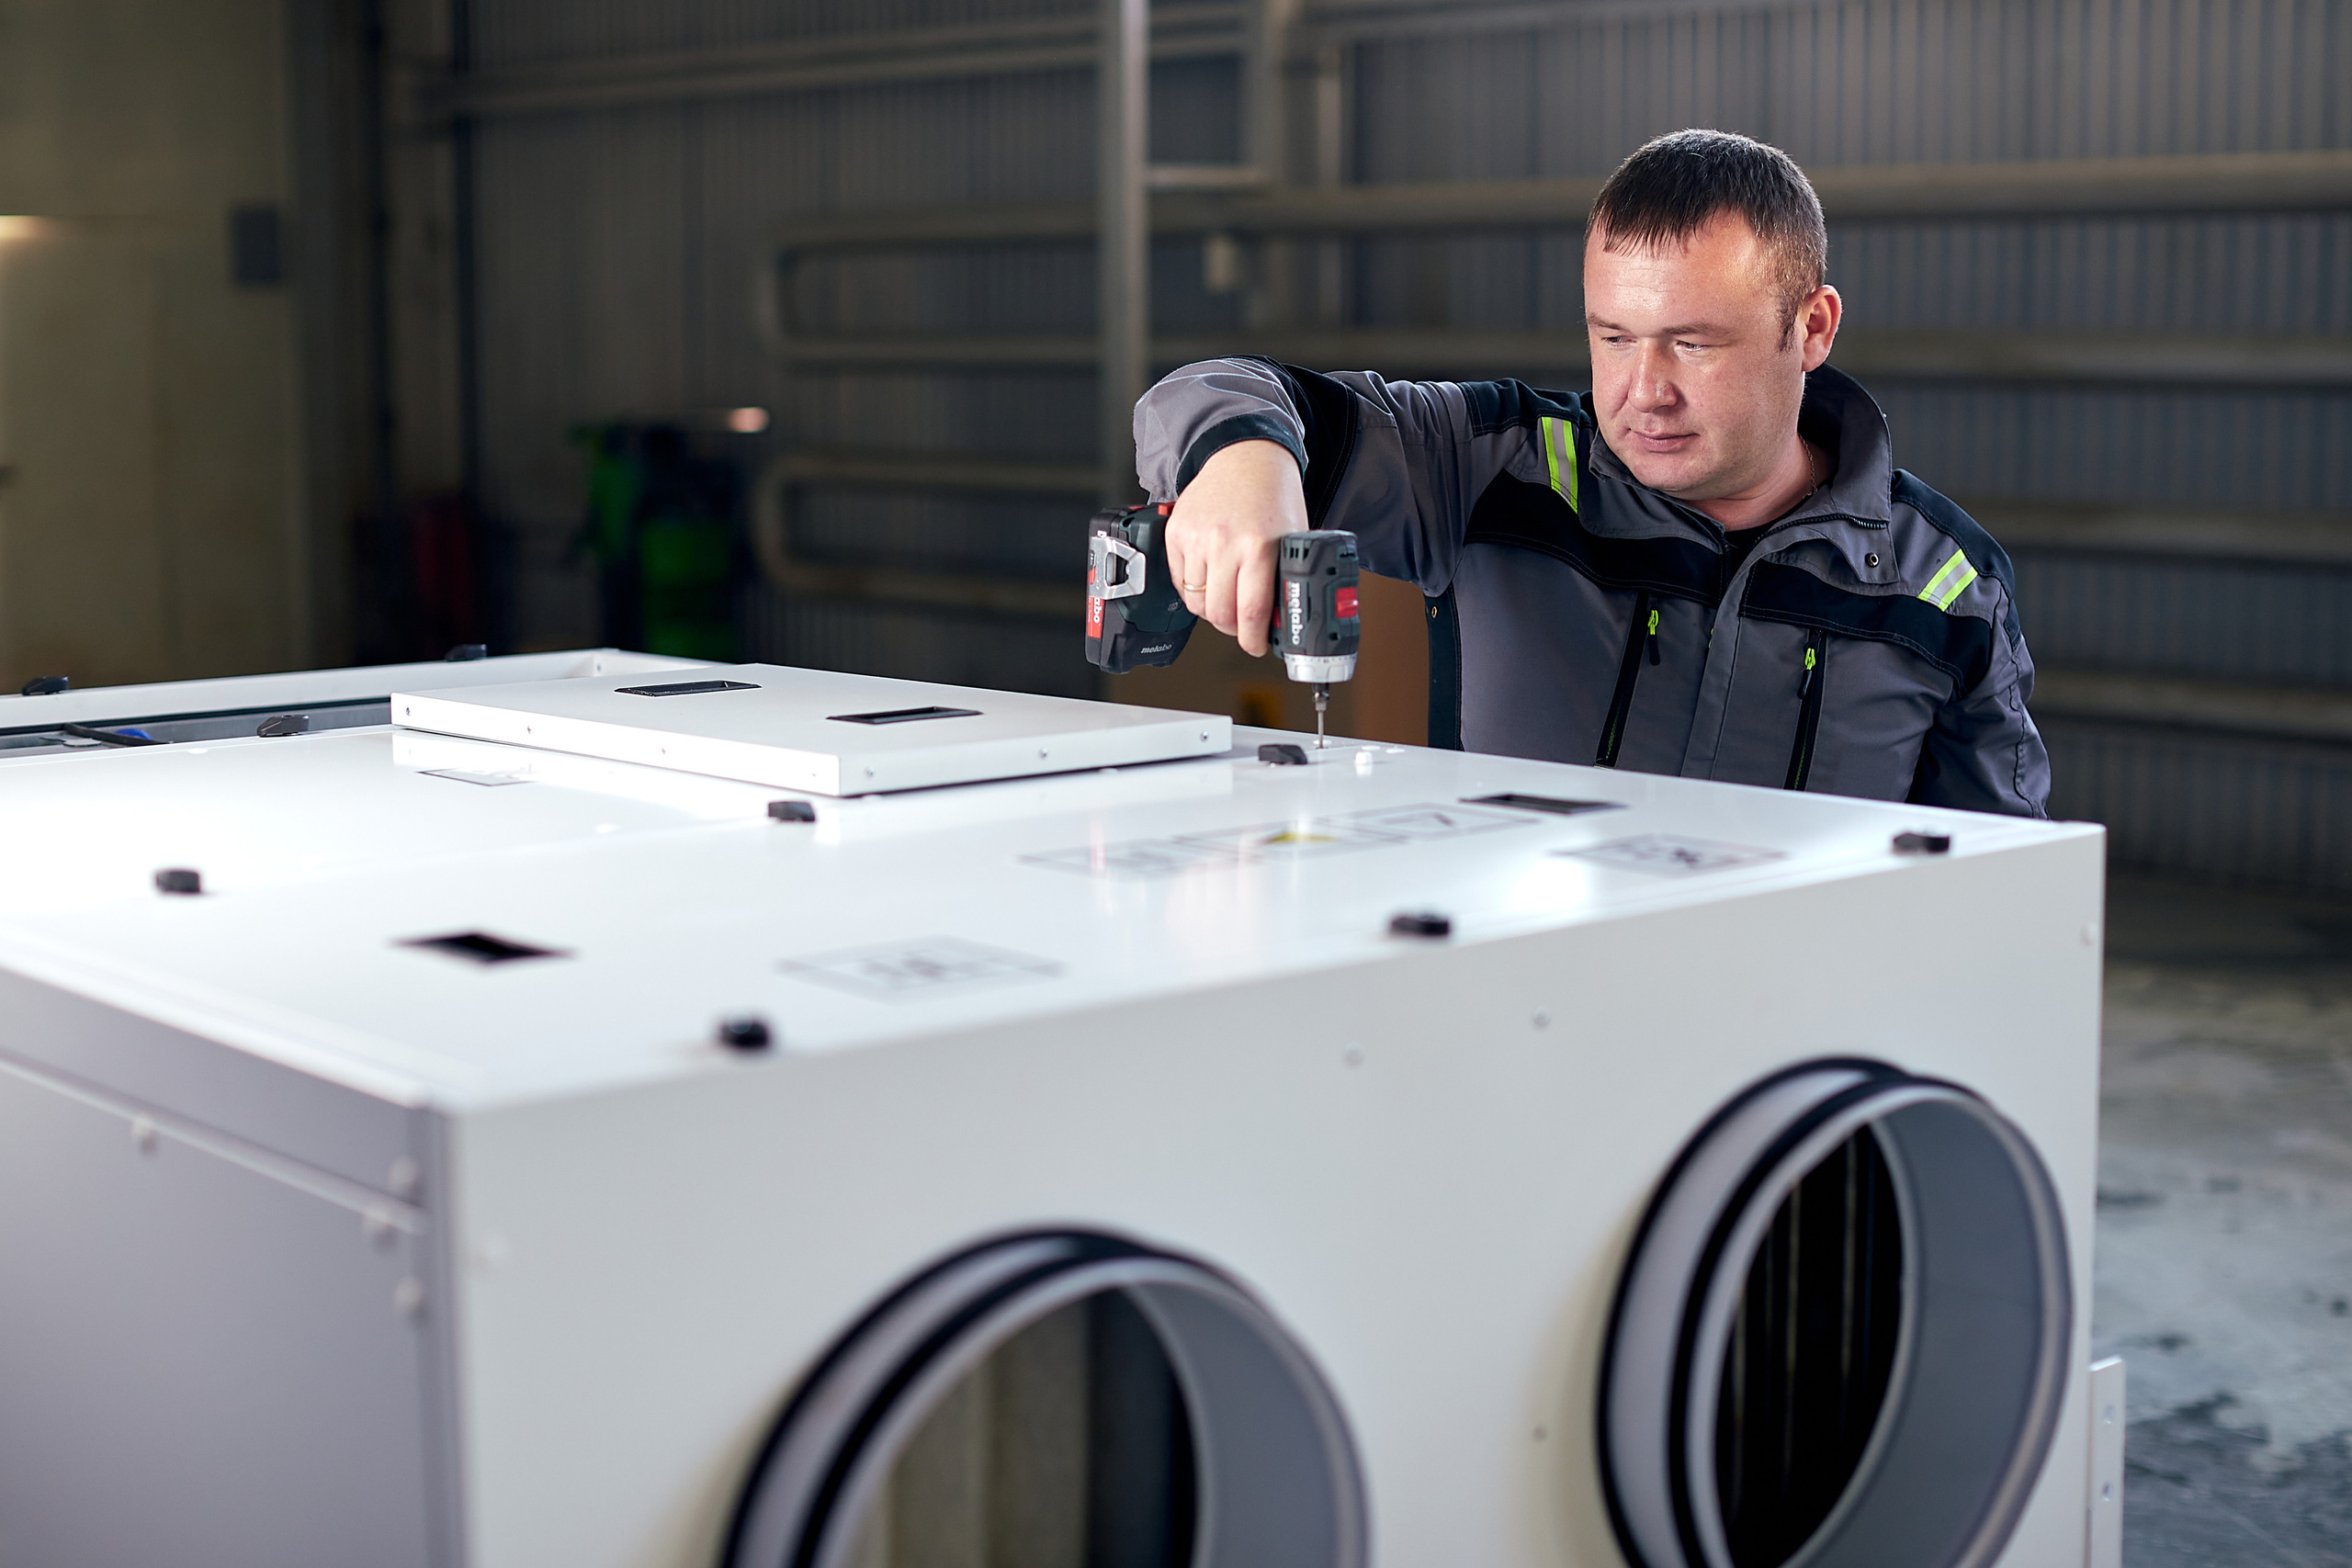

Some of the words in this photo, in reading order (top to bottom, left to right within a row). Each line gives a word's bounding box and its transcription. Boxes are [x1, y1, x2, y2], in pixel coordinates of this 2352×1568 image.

[1093, 597, 1102, 624] abo
[1291, 582, 1304, 646] metabo
[1140, 644, 1172, 654] metabo
